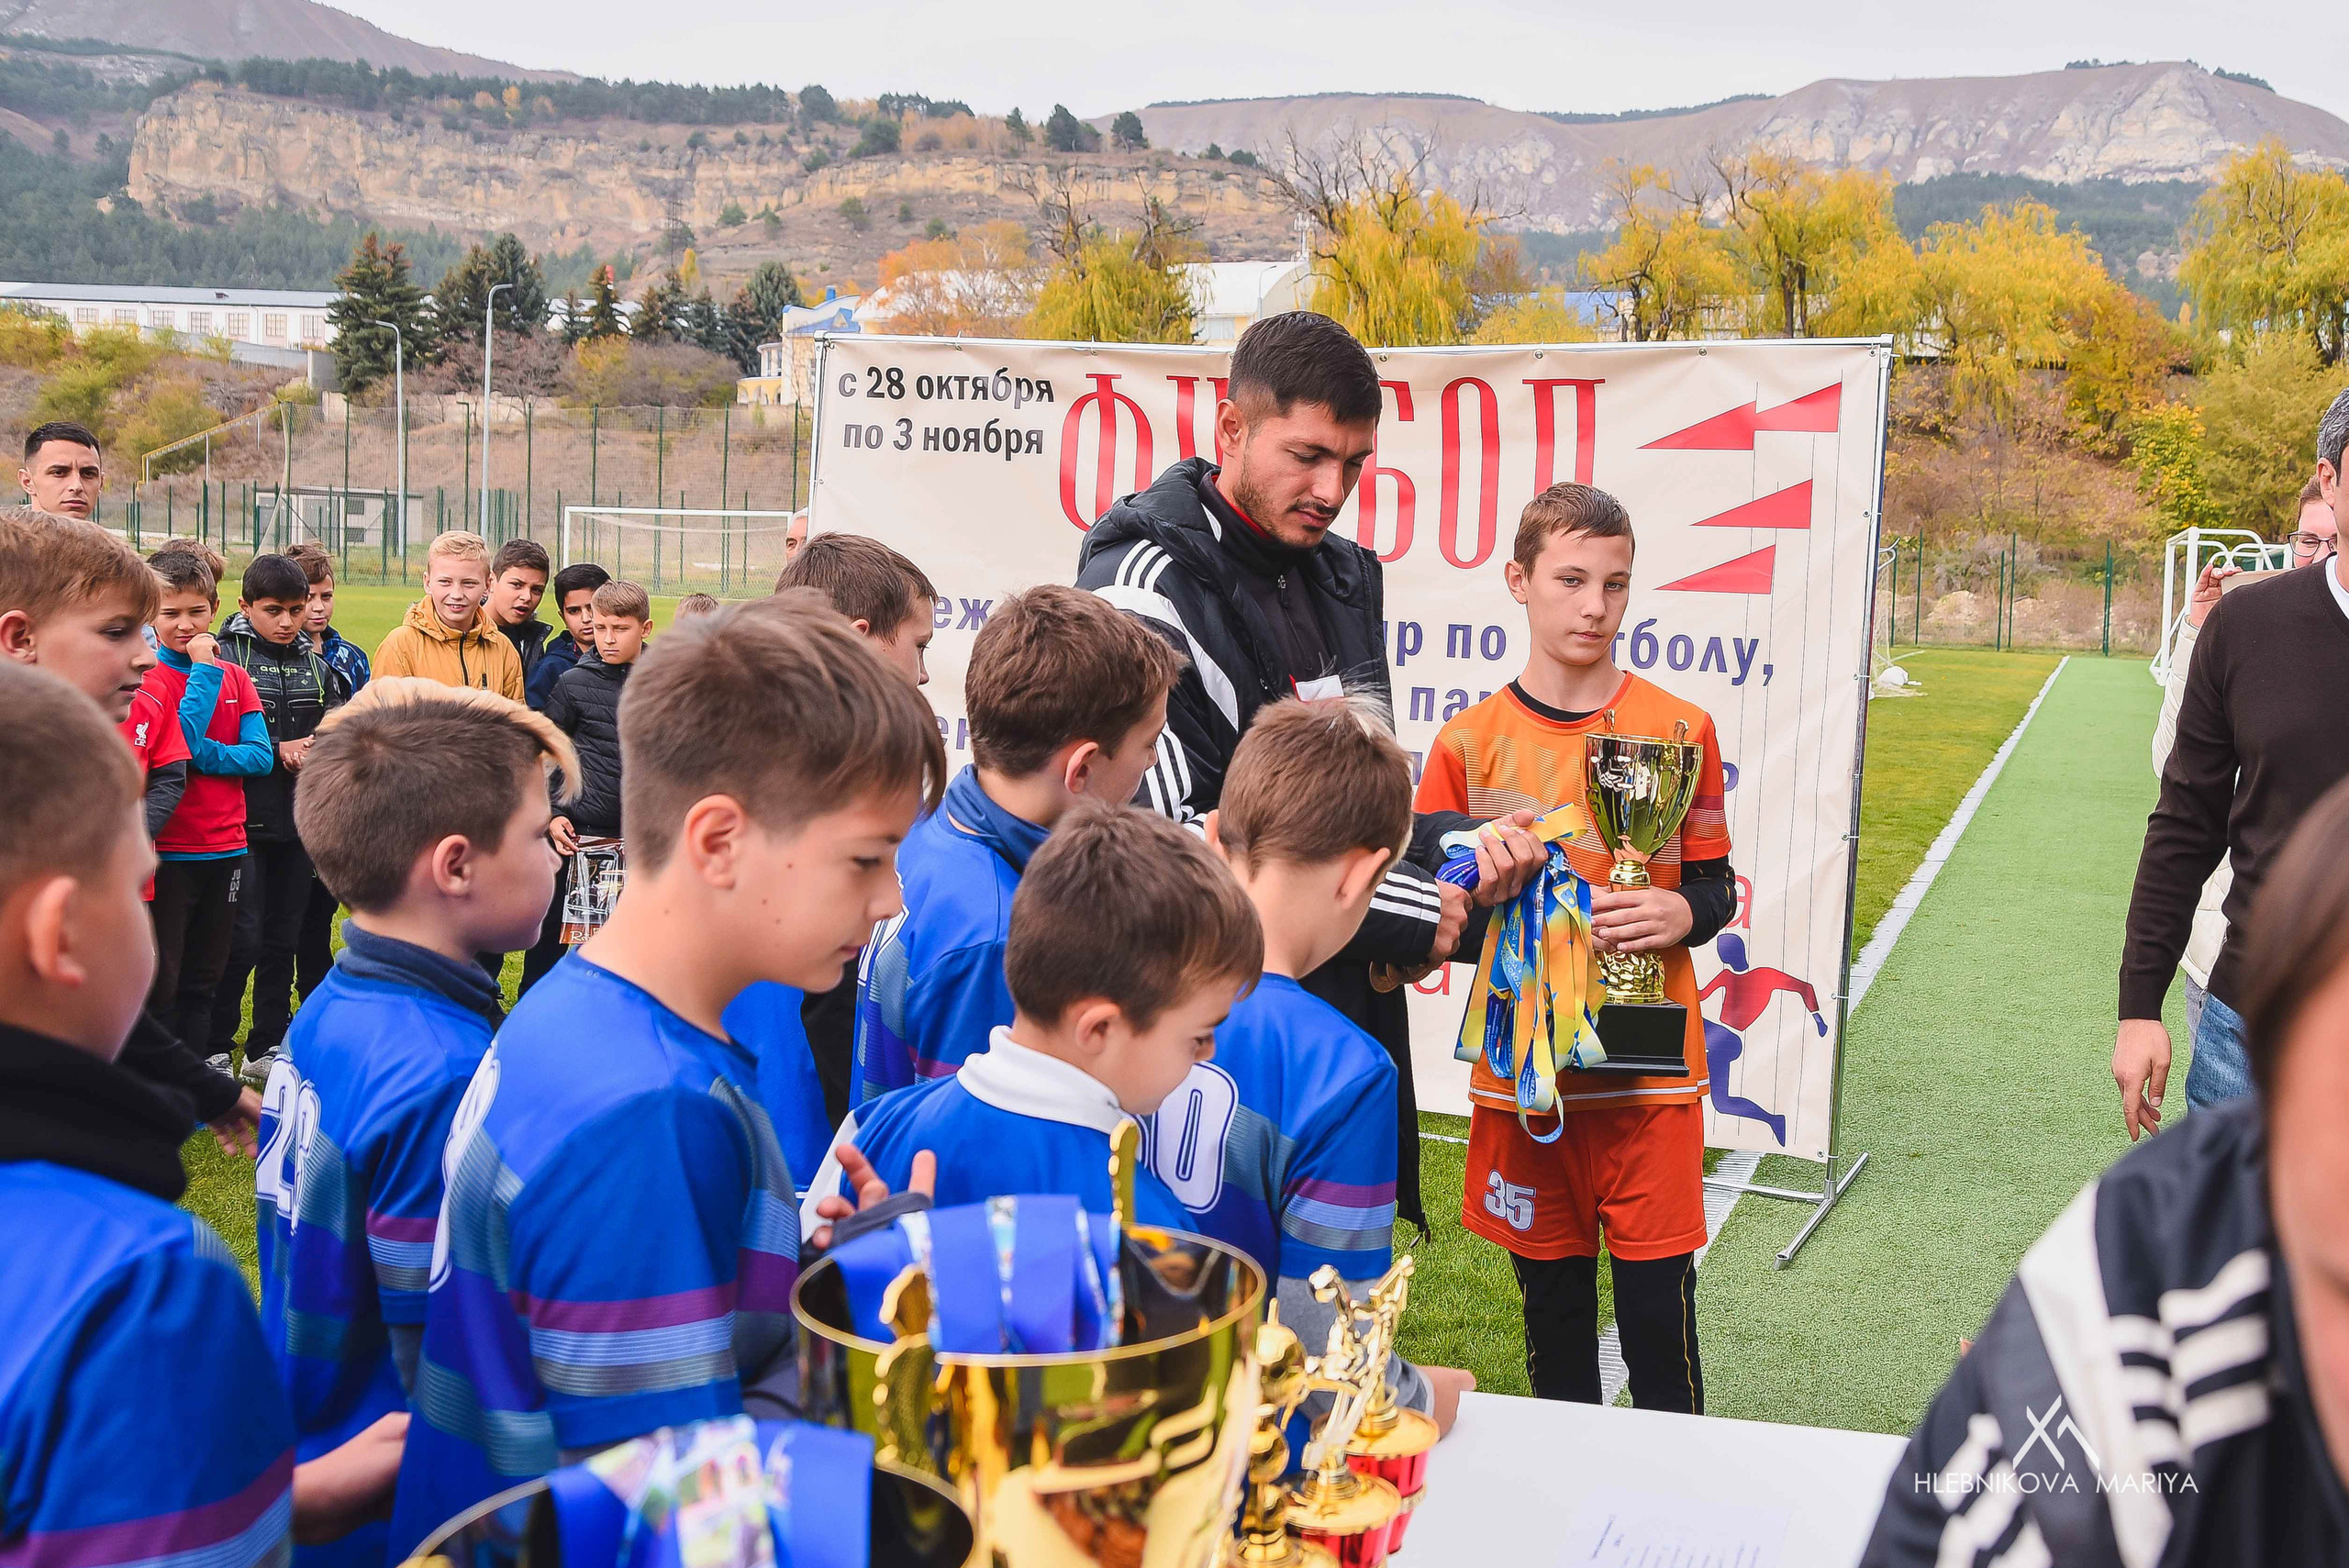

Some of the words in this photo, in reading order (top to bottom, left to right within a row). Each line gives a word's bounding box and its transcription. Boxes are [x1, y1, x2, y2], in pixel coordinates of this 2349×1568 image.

[839, 373, 857, 397] с
[866, 366, 906, 400] 28
[916, 366, 1054, 409] октября
[843, 424, 884, 450] по
[893, 417, 913, 450] 3
[923, 417, 1044, 462] ноября
[1446, 624, 1507, 661] по
[1483, 1168, 1537, 1232] 35
